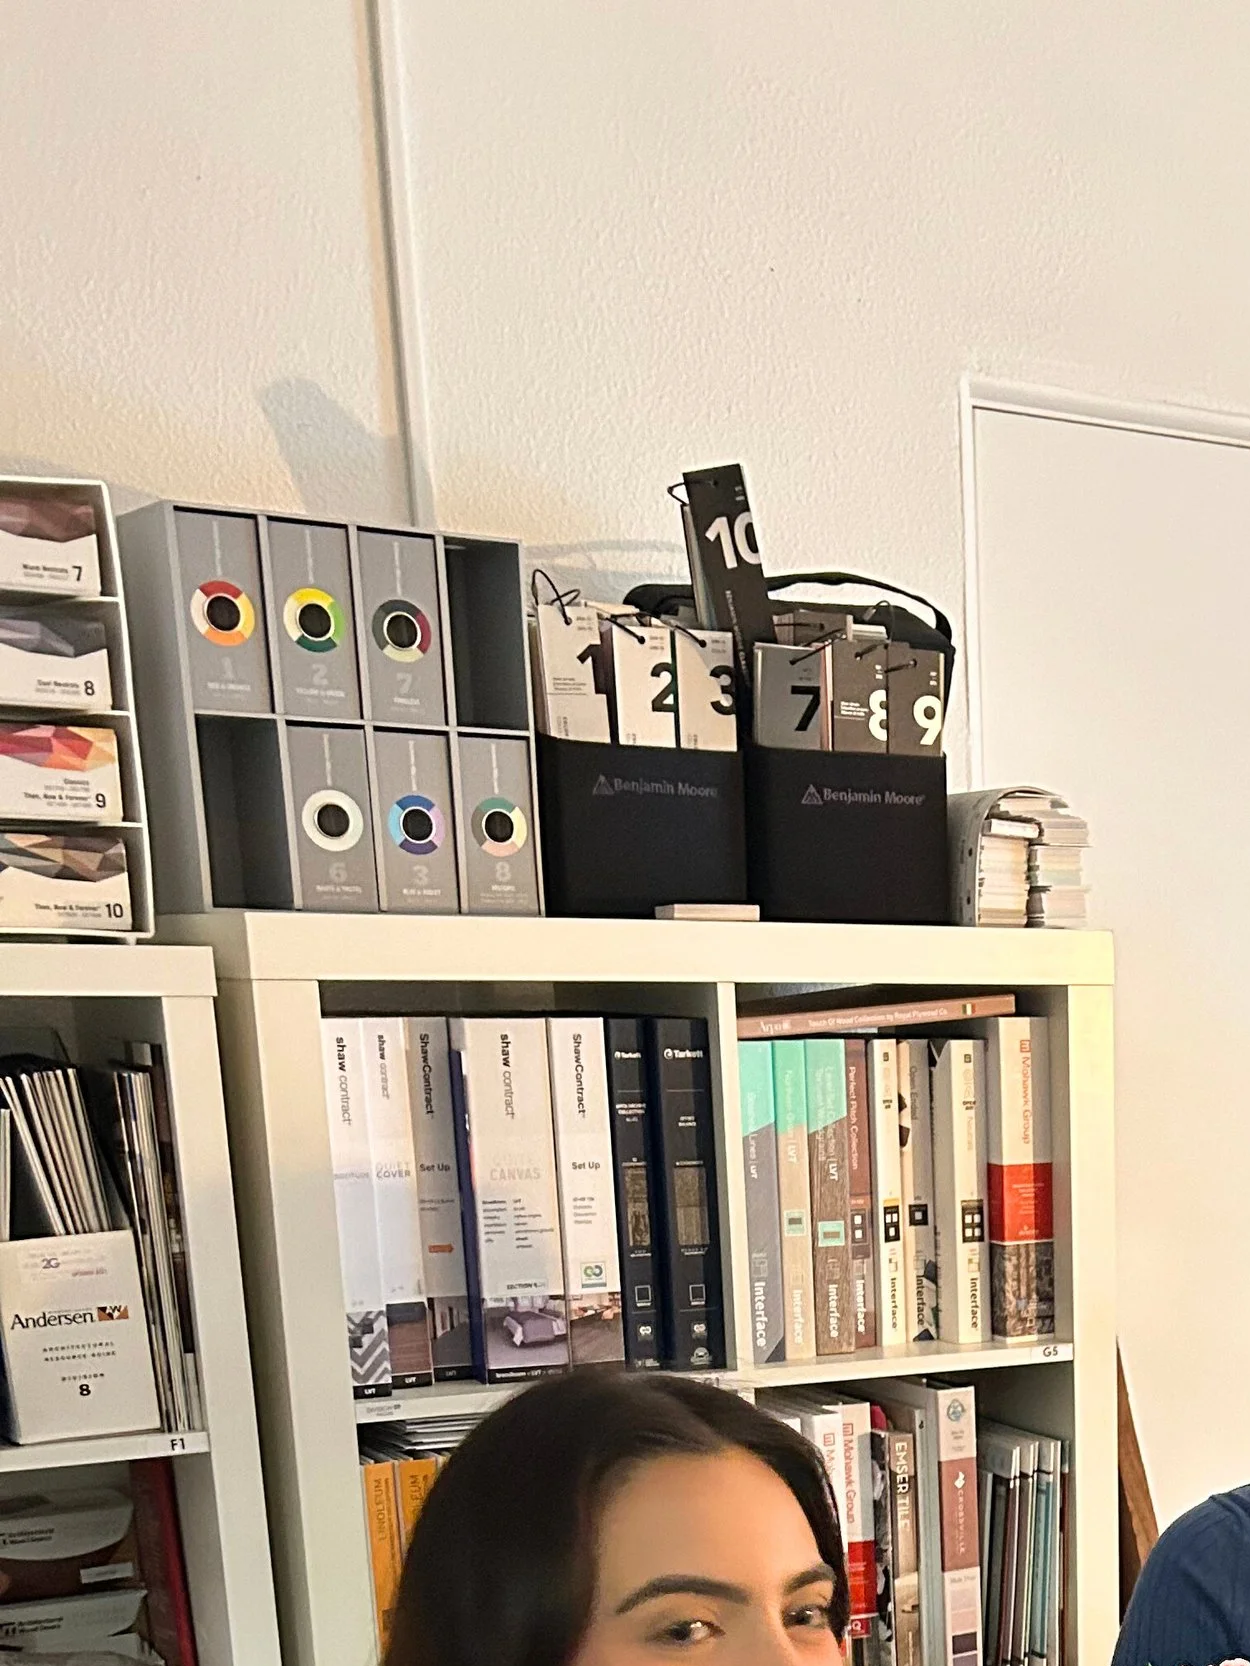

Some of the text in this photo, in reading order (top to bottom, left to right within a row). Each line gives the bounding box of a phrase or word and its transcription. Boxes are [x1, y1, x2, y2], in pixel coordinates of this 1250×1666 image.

[705, 511, 761, 569] 10
[72, 565, 83, 581] 7
[221, 656, 234, 681] 1
[311, 663, 329, 686] 2
[577, 644, 606, 694] 1
[84, 680, 95, 696] 8
[396, 672, 413, 695] 7
[651, 662, 677, 712] 2
[710, 665, 736, 715] 3
[791, 685, 821, 731] 7
[868, 689, 888, 742] 8
[913, 695, 942, 745] 9
[95, 793, 106, 808] 9
[613, 778, 718, 798] Benjamin Moore
[823, 788, 923, 806] Benjamin Moore
[329, 862, 348, 883] 6
[413, 865, 430, 886] 3
[495, 861, 511, 882] 8
[105, 903, 124, 918] 10
[674, 1050, 703, 1058] Tarkett
[378, 1035, 389, 1099] shaw contract
[420, 1033, 434, 1115] ShawContract
[500, 1033, 515, 1118] shaw contract
[573, 1033, 585, 1118] ShawContract
[336, 1037, 351, 1123] shaw contract
[849, 1066, 857, 1099] Perfect
[1022, 1056, 1032, 1144] Mohawk Group
[749, 1134, 758, 1159] Lines
[850, 1126, 858, 1170] Collection
[376, 1170, 411, 1178] COVER
[420, 1163, 451, 1172] Set Up
[490, 1168, 542, 1181] CANVAS
[572, 1162, 601, 1170] Set Up
[829, 1163, 838, 1181] LVT
[42, 1257, 60, 1269] 2G
[828, 1284, 839, 1338] Interface
[856, 1280, 865, 1332] Interface
[890, 1278, 898, 1329] Interface
[916, 1275, 925, 1326] Interface
[970, 1278, 978, 1329] Interface
[10, 1311, 94, 1331] Andersen
[754, 1282, 767, 1346] Interface
[792, 1290, 803, 1345] Interface
[42, 1341, 115, 1353] ARCHITECTURAL
[44, 1353, 87, 1362] RESOURCE
[1043, 1346, 1059, 1358] G5
[61, 1373, 105, 1382] DIVISION
[79, 1384, 91, 1396] 8
[405, 1376, 417, 1384] LVT
[170, 1438, 186, 1451] F1
[844, 1439, 856, 1523] Mohawk Group
[896, 1442, 910, 1529] EMSER TILE
[374, 1478, 387, 1541] LINOLEUM
[957, 1490, 965, 1554] CROSSVILLE
